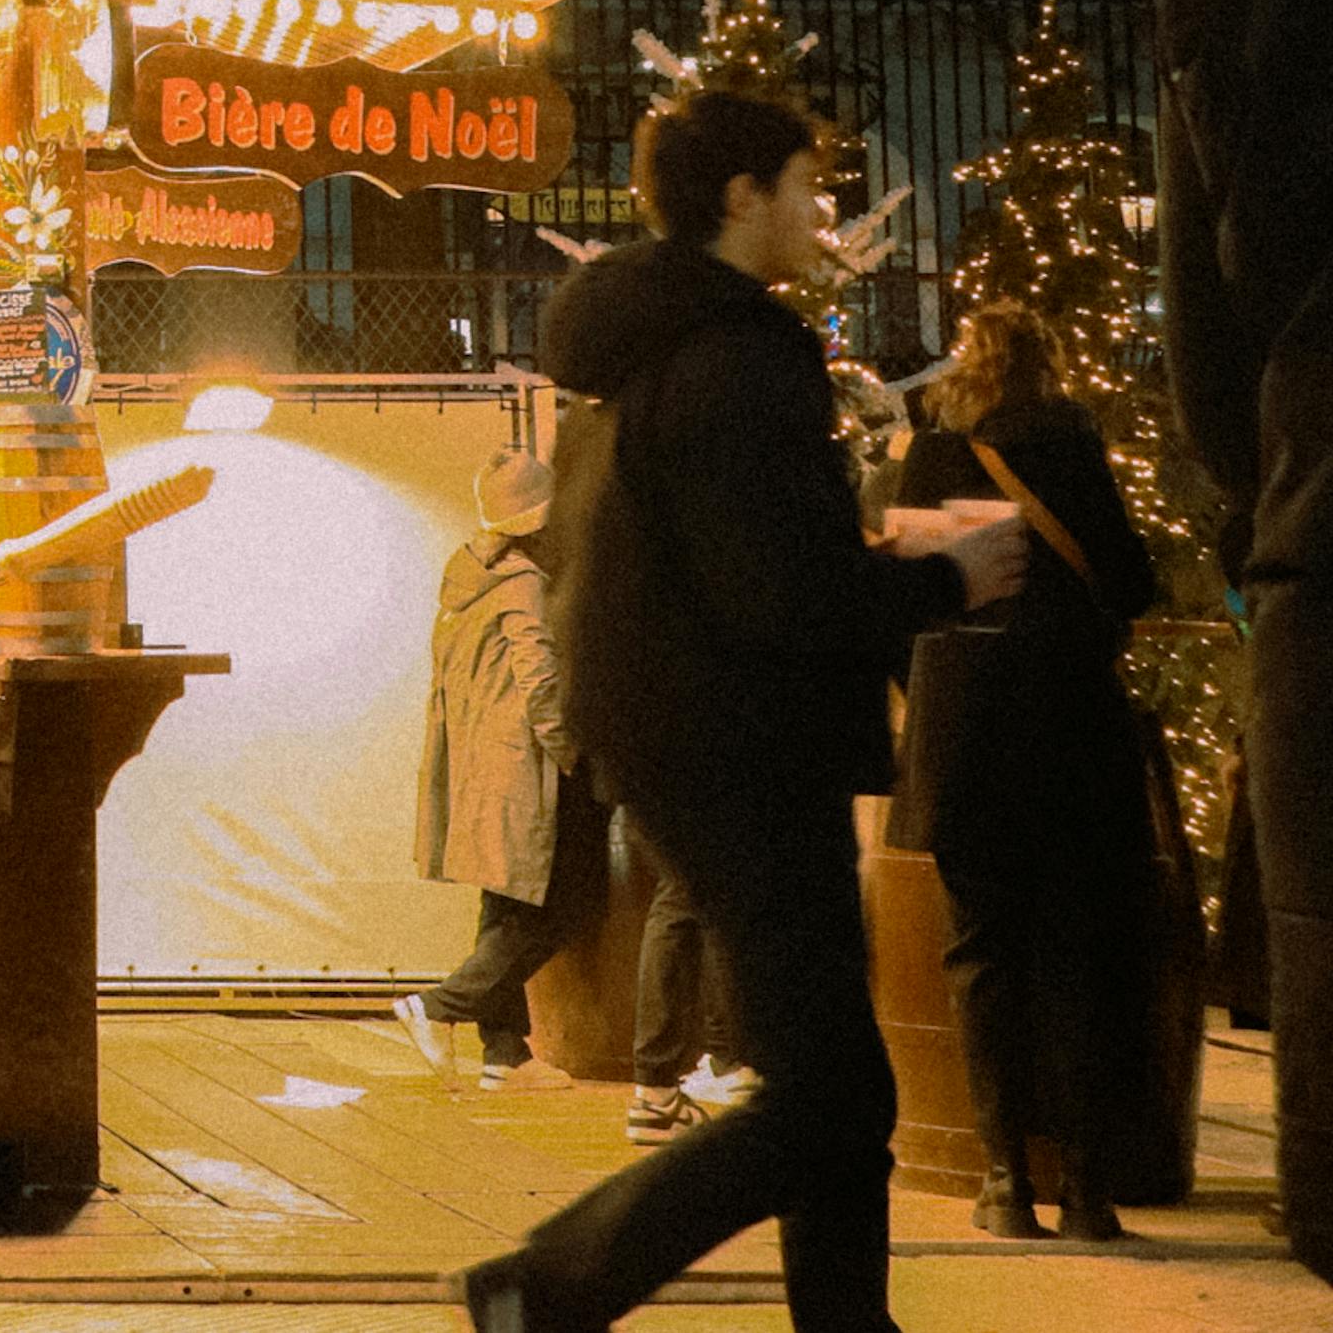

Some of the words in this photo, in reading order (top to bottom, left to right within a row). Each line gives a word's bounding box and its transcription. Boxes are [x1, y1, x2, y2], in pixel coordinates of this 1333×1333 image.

[161, 77, 315, 150] Bière
[330, 85, 397, 156] de
[410, 87, 538, 162] Noël
